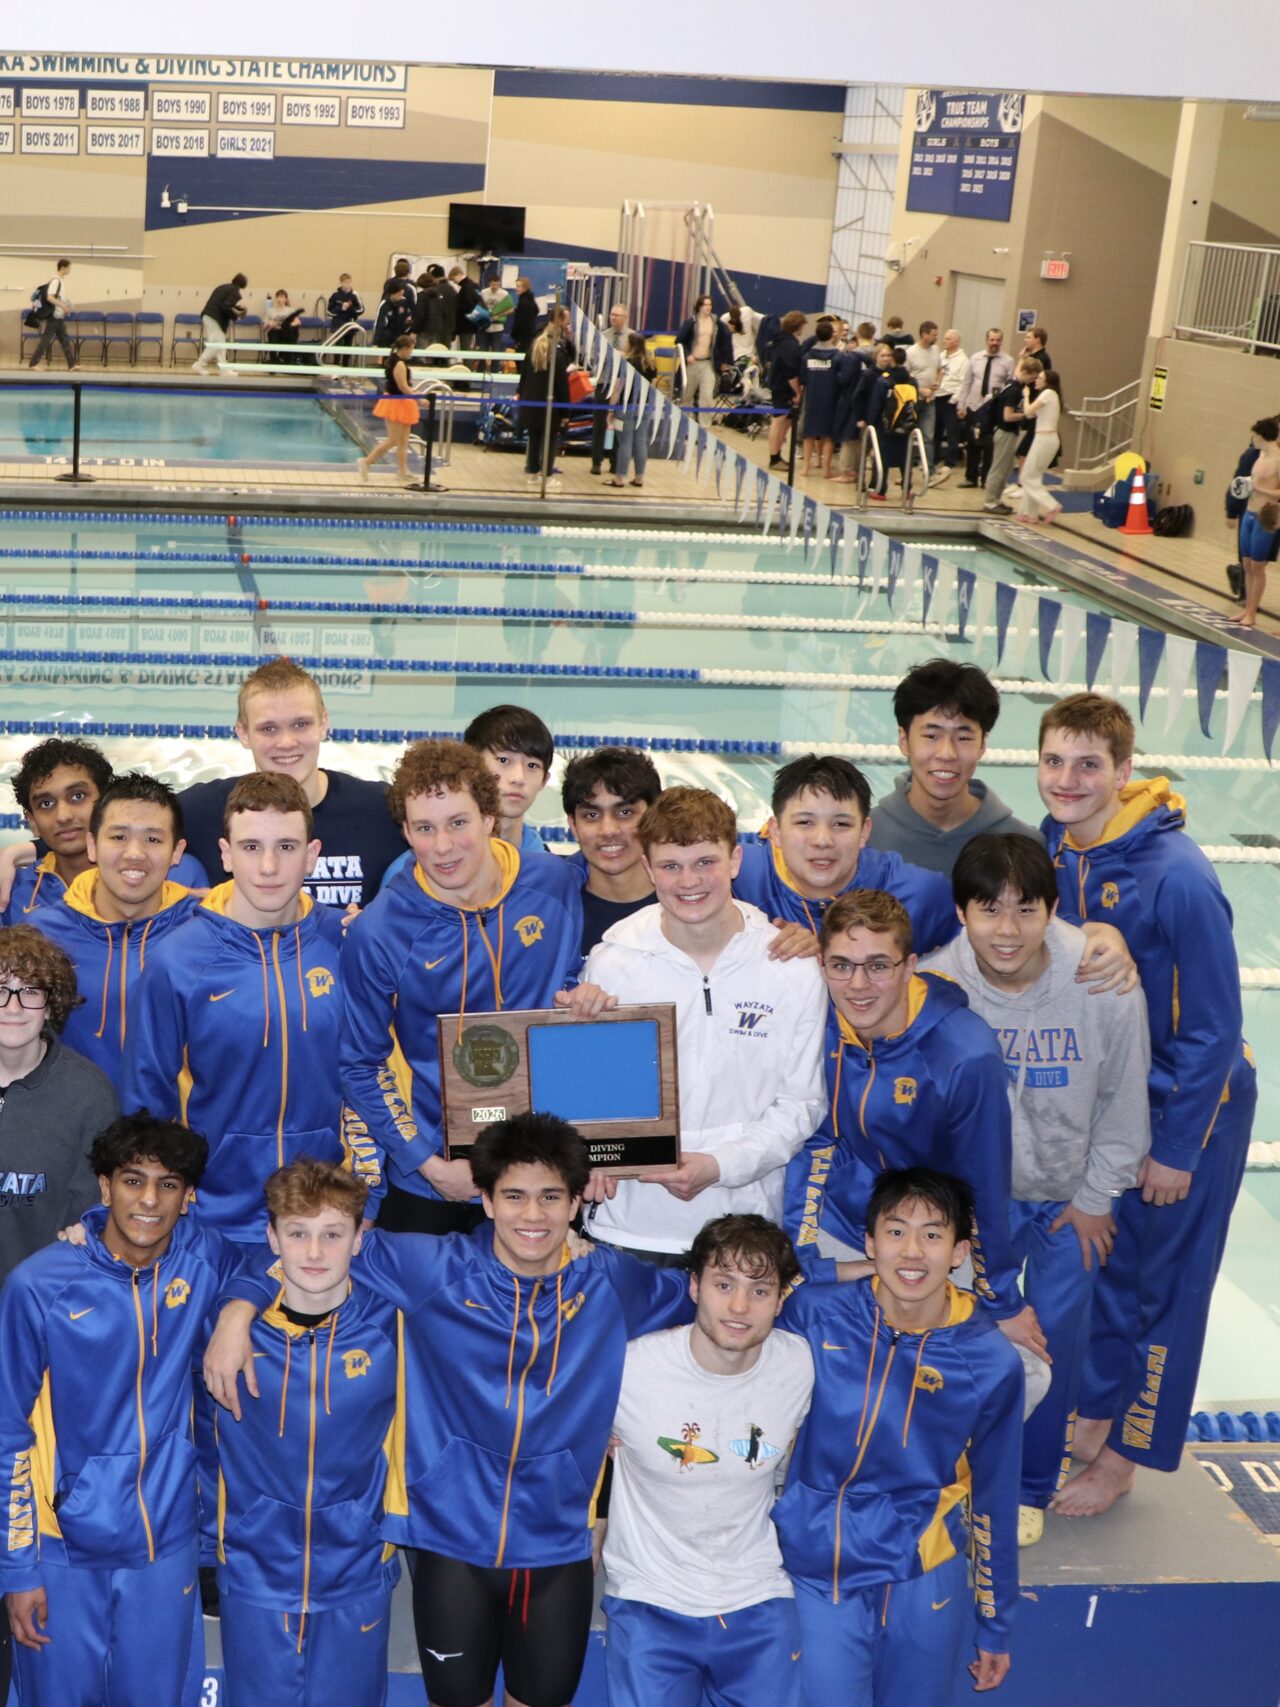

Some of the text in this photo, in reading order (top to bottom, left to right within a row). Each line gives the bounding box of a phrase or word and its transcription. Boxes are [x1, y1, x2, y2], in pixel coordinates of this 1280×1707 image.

[29, 54, 129, 73] SWIMMING
[135, 57, 150, 74] &
[156, 59, 220, 76] DIVING
[226, 60, 283, 78] STATE
[287, 62, 397, 82] CHAMPIONS
[26, 95, 75, 111] BOYS 1978
[91, 96, 141, 113] BOYS 1988
[157, 98, 206, 114] BOYS 1990
[223, 100, 272, 116] BOYS 1991
[946, 101, 988, 116] TRUE TEAM
[286, 103, 336, 119] BOYS 1992
[352, 105, 401, 121] BOYS 1993
[941, 117, 989, 128] CHAMPIONSHIPS
[26, 132, 75, 147] BOYS 2011
[91, 133, 140, 148] BOYS 2017
[157, 135, 205, 150] BOYS 2018
[220, 137, 272, 152] GIRLS 2021
[980, 139, 1000, 148] BOYS
[143, 459, 166, 467] IN
[305, 856, 364, 879] ATA
[316, 885, 363, 904] DIVE
[735, 1001, 774, 1015] WAYZATA
[737, 1011, 768, 1029] W
[1035, 1071, 1062, 1086] DIVE
[473, 1108, 505, 1122] 2026
[590, 1144, 625, 1152] DIVING
[1086, 1595, 1099, 1628] 1
[201, 1677, 219, 1707] 3
